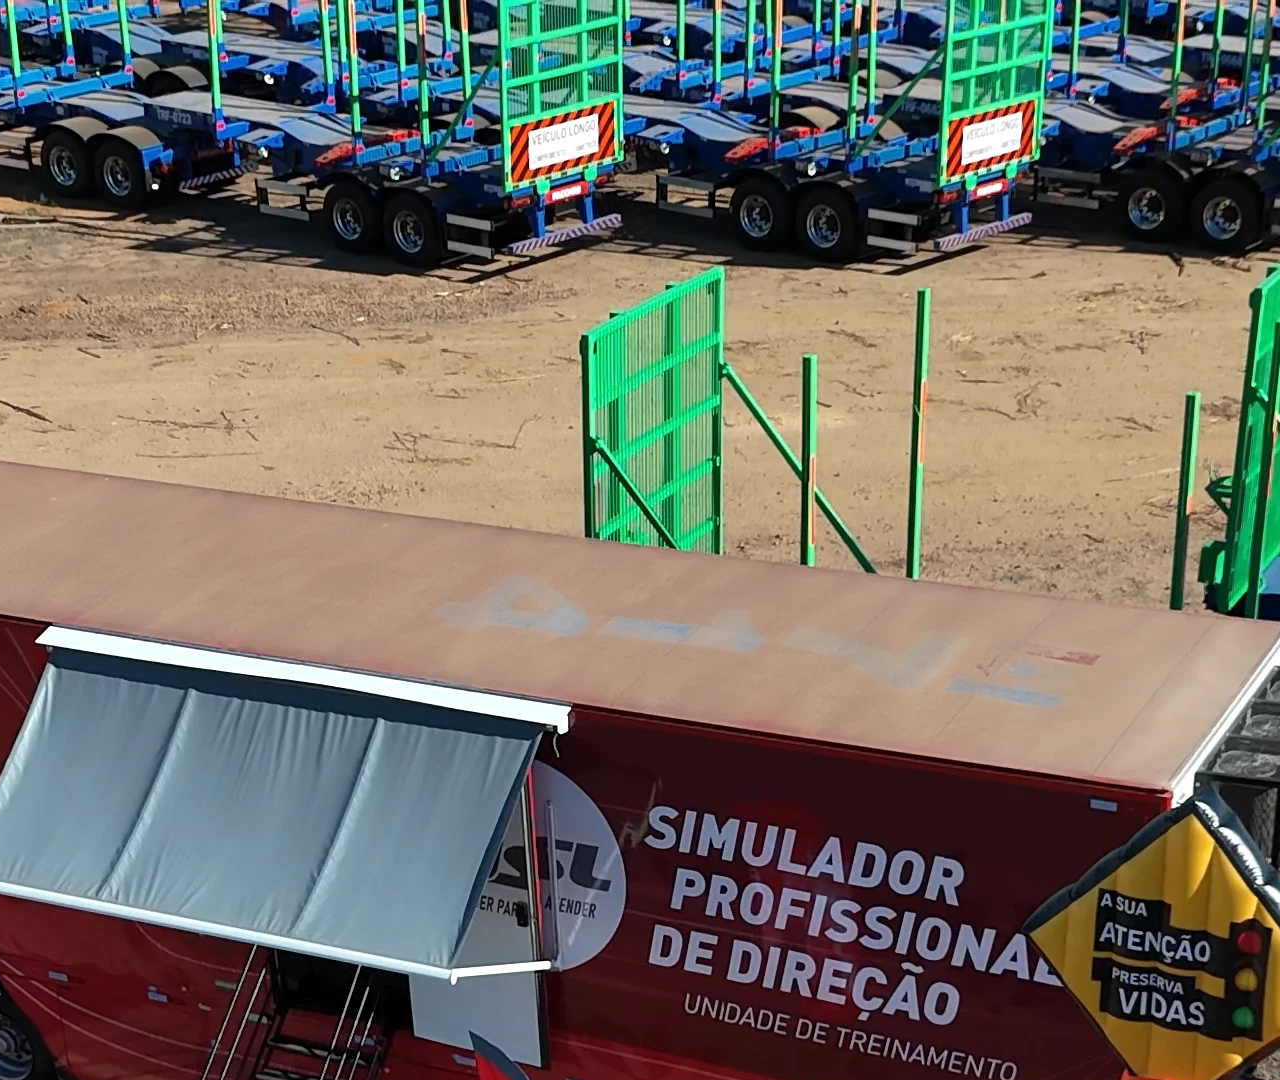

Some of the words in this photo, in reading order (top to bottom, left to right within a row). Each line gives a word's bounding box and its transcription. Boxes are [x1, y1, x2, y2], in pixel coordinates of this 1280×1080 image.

[568, 118, 596, 137] LONGO
[644, 805, 965, 907] SIMULADOR
[544, 895, 598, 919] AENDER
[1100, 893, 1113, 908] A
[1115, 897, 1148, 918] SUA
[1099, 921, 1211, 963] ATENÇÃO
[648, 924, 719, 977] DE
[726, 939, 961, 1027] DIREÇÃO
[1111, 966, 1184, 996] PRESERVA
[684, 993, 791, 1037] UNIDADE
[795, 1018, 830, 1045] DE
[1118, 987, 1205, 1026] VIDAS
